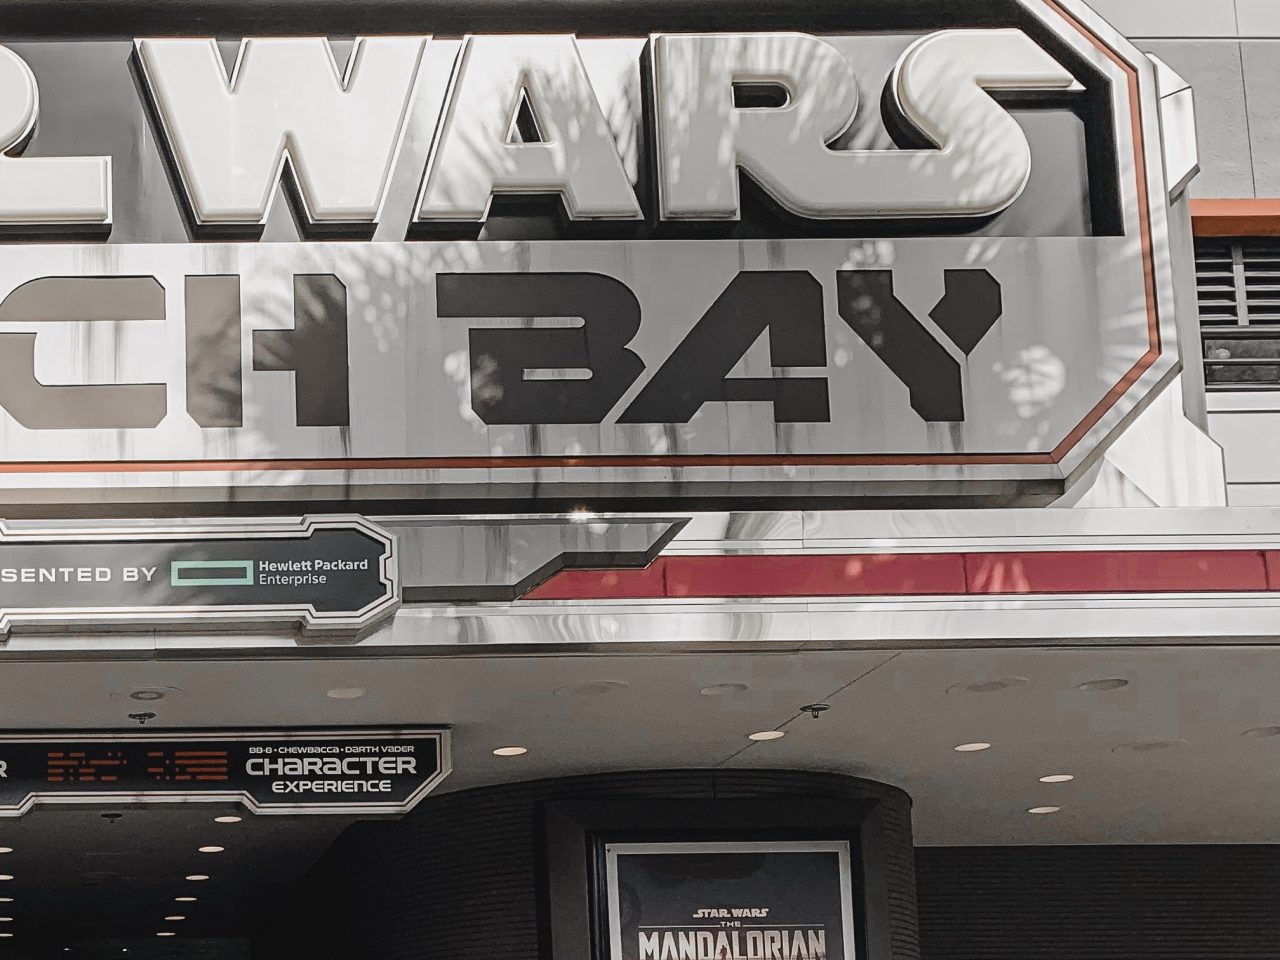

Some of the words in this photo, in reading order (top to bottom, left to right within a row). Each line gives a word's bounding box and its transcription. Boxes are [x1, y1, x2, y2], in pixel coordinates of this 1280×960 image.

[134, 28, 1086, 222] WARS
[434, 267, 1002, 426] BAY
[258, 560, 312, 572] Hewlett
[314, 558, 369, 571] Packard
[122, 566, 158, 582] BY
[258, 572, 327, 586] Enterprise
[692, 908, 731, 918] STAR
[732, 908, 770, 918] WARS
